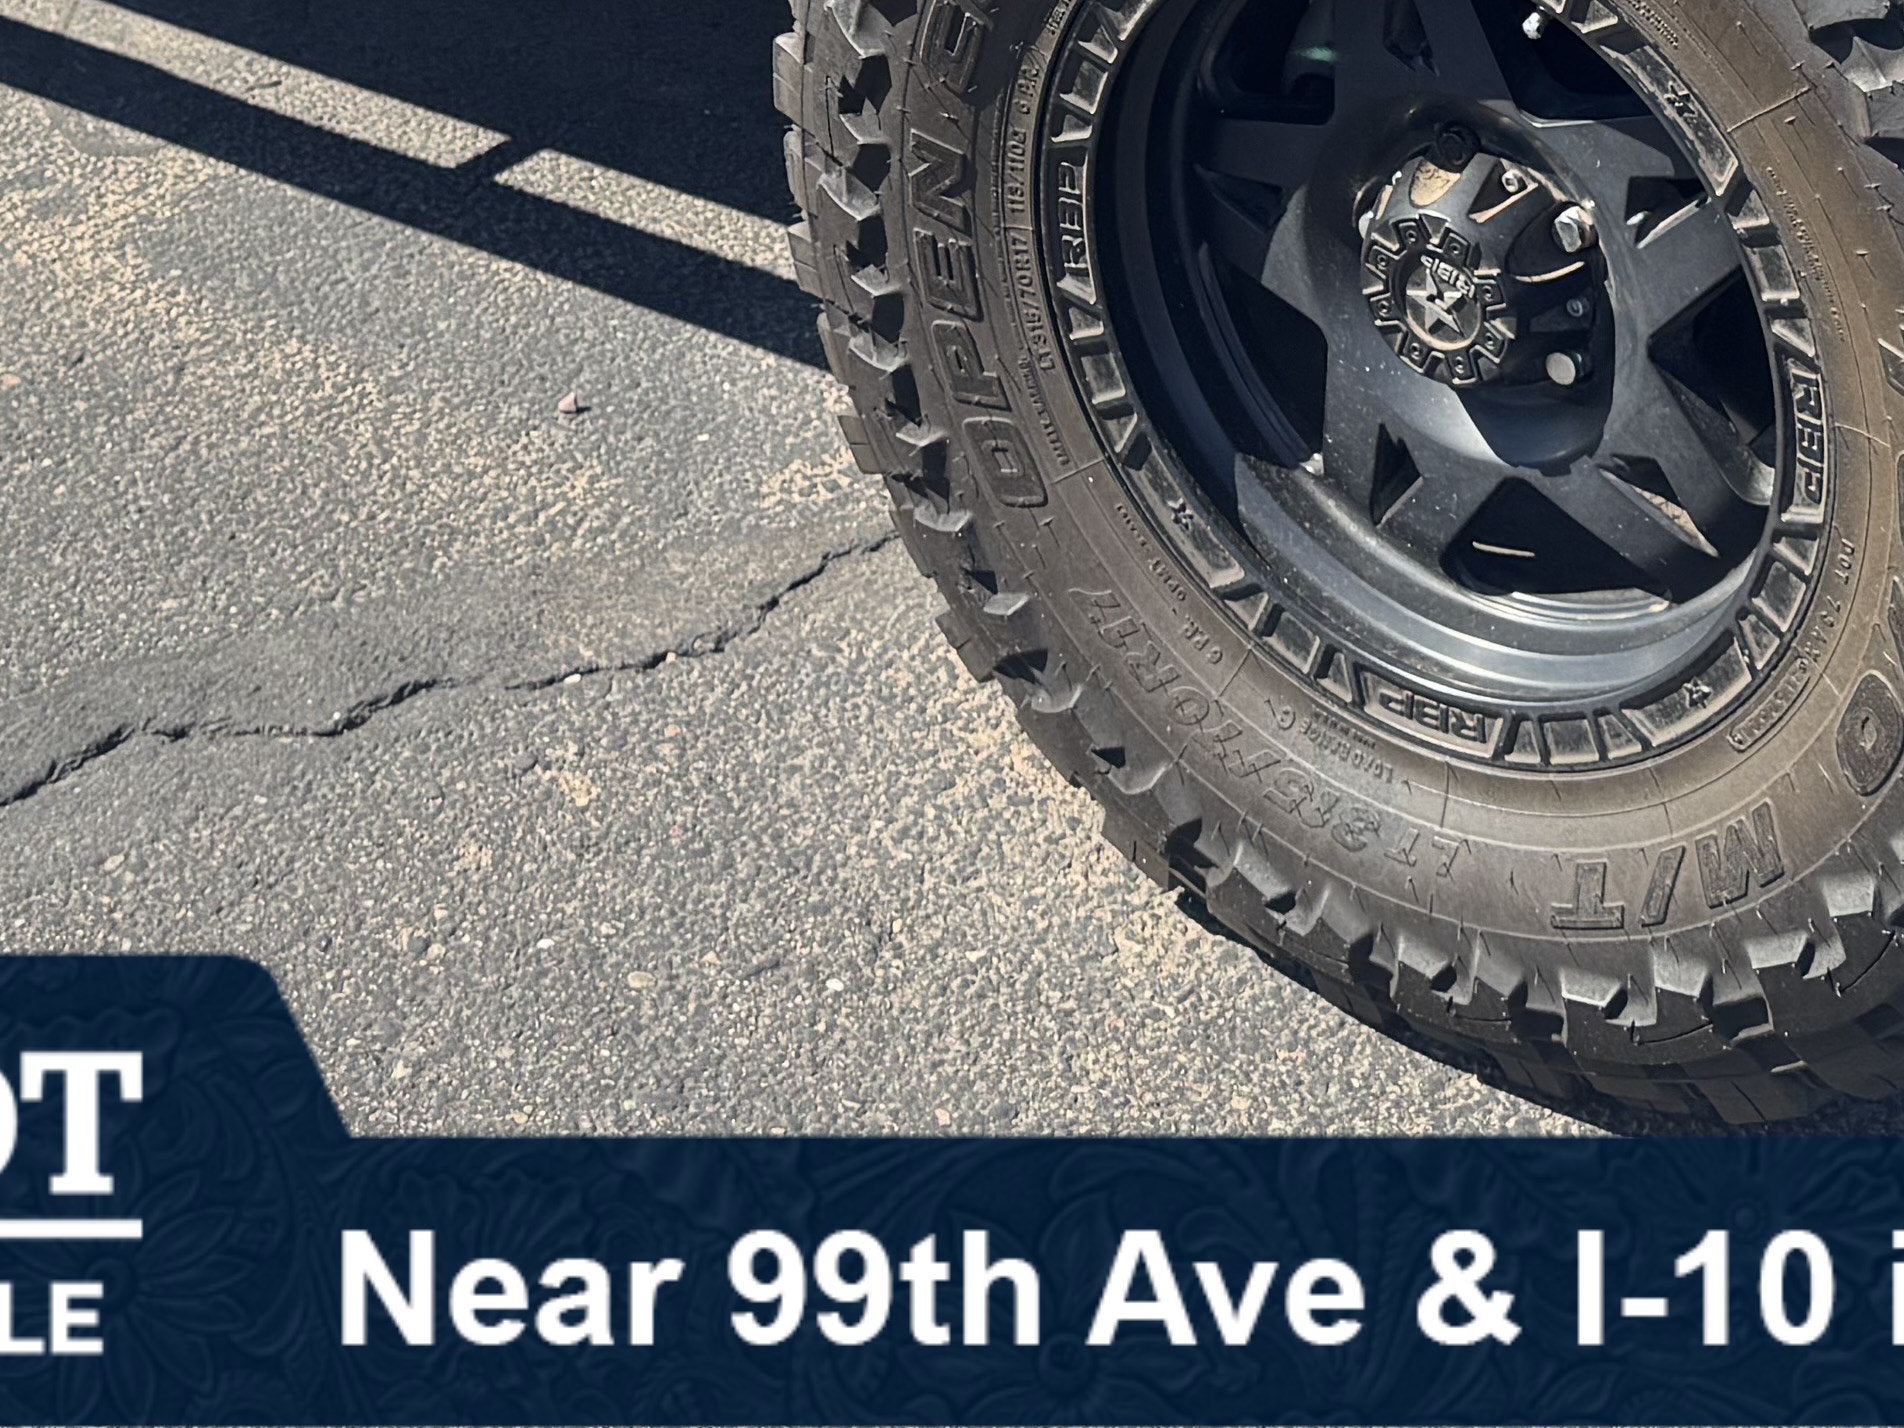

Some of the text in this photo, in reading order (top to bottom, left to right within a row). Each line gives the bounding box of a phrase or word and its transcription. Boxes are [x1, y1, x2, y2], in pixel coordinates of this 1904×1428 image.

[1057, 160, 1084, 286] RBP
[907, 128, 1050, 510] OPEN
[1796, 380, 1824, 505] RBP
[1379, 689, 1488, 746] RBP
[1549, 796, 1786, 931] M/T
